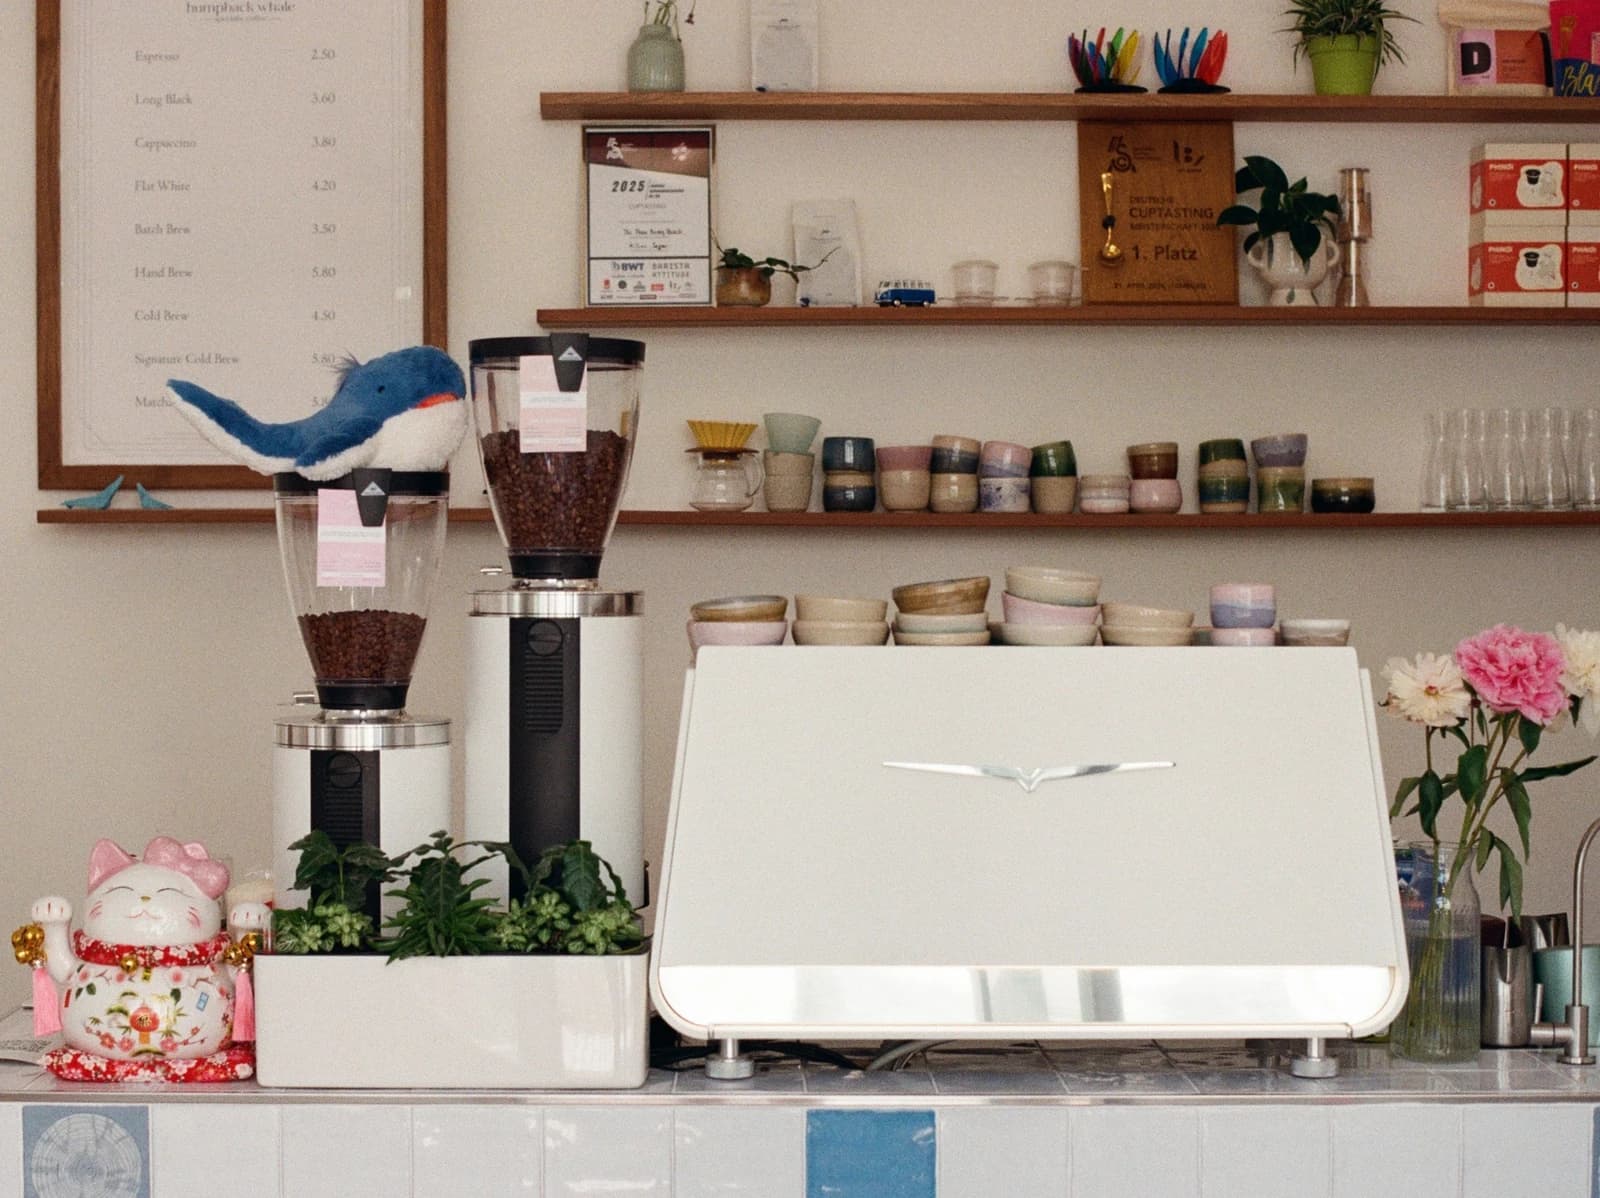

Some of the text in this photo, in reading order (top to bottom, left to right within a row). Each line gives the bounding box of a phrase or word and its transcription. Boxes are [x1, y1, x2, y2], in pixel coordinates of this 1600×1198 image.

[185, 0, 296, 16] humpback whale
[134, 49, 180, 63] Espresso
[311, 48, 336, 60] 2.50
[1460, 42, 1492, 76] D
[134, 93, 193, 107] Long Black
[311, 92, 336, 104] 3.60
[134, 136, 197, 152] Cappuccino
[311, 136, 336, 148] 3.80
[134, 179, 191, 192] Flat White
[311, 179, 336, 191] 4.20
[611, 180, 646, 193] 2025
[1129, 207, 1214, 219] CUPTASTING
[134, 222, 191, 235] Batch Brew
[311, 223, 336, 235] 3.50
[1154, 245, 1198, 260] Platz
[134, 266, 193, 279] Hand Brew
[311, 266, 336, 278] 5.80
[621, 262, 645, 271] BWT
[134, 309, 189, 322] Cold Brew
[311, 309, 336, 321] 4.50
[134, 352, 240, 368] Signature Cold Brew
[311, 353, 336, 365] 5.80
